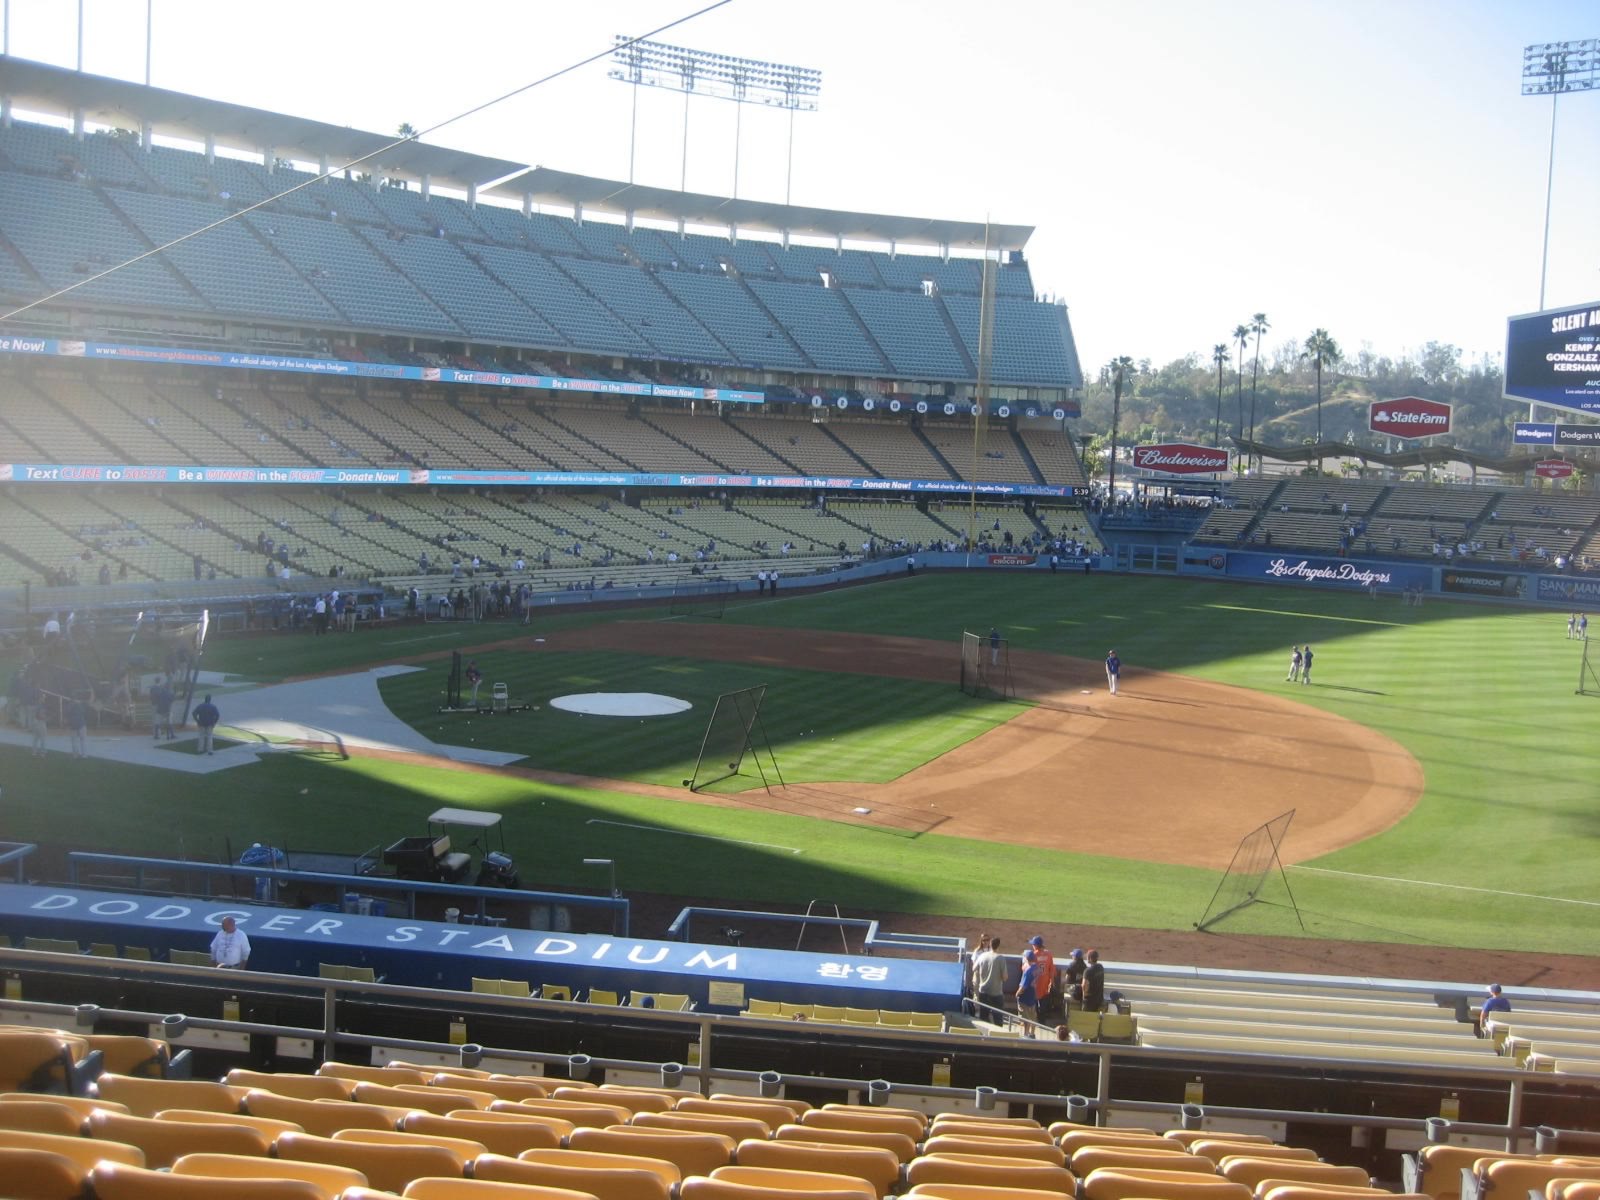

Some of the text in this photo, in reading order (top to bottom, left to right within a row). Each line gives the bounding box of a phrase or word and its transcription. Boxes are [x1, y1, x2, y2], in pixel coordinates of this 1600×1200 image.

[1551, 312, 1587, 333] SILENT
[12, 339, 46, 352] Now!
[1565, 343, 1593, 352] KEMP
[1545, 353, 1598, 362] GONZALEZ
[453, 371, 474, 382] Text
[502, 375, 511, 385] to
[552, 379, 562, 389] Be
[601, 382, 608, 391] in
[609, 383, 620, 393] the
[654, 386, 696, 398] Donate Now!
[1390, 411, 1447, 425] State Farm
[1516, 429, 1553, 439] @Dodgers
[1560, 431, 1593, 441] Dodgers
[1137, 449, 1226, 467] Budweiser
[26, 467, 59, 480] Text
[106, 469, 121, 480] to
[178, 469, 194, 481] Be
[196, 472, 203, 481] a
[257, 470, 267, 481] in
[270, 471, 288, 481] the
[338, 471, 374, 482] Donate
[375, 472, 400, 483] Now!
[680, 476, 695, 485] Text
[719, 477, 727, 485] to
[757, 478, 766, 486] Be
[805, 479, 812, 487] in
[814, 479, 826, 487] the
[863, 480, 889, 489] Donate
[891, 481, 912, 490] Now!
[1074, 488, 1089, 496] 5:39
[1265, 559, 1391, 586] Los Angeles Dodgers
[30, 894, 737, 971] DODGER STADIUM
[816, 962, 889, 981] 환영
